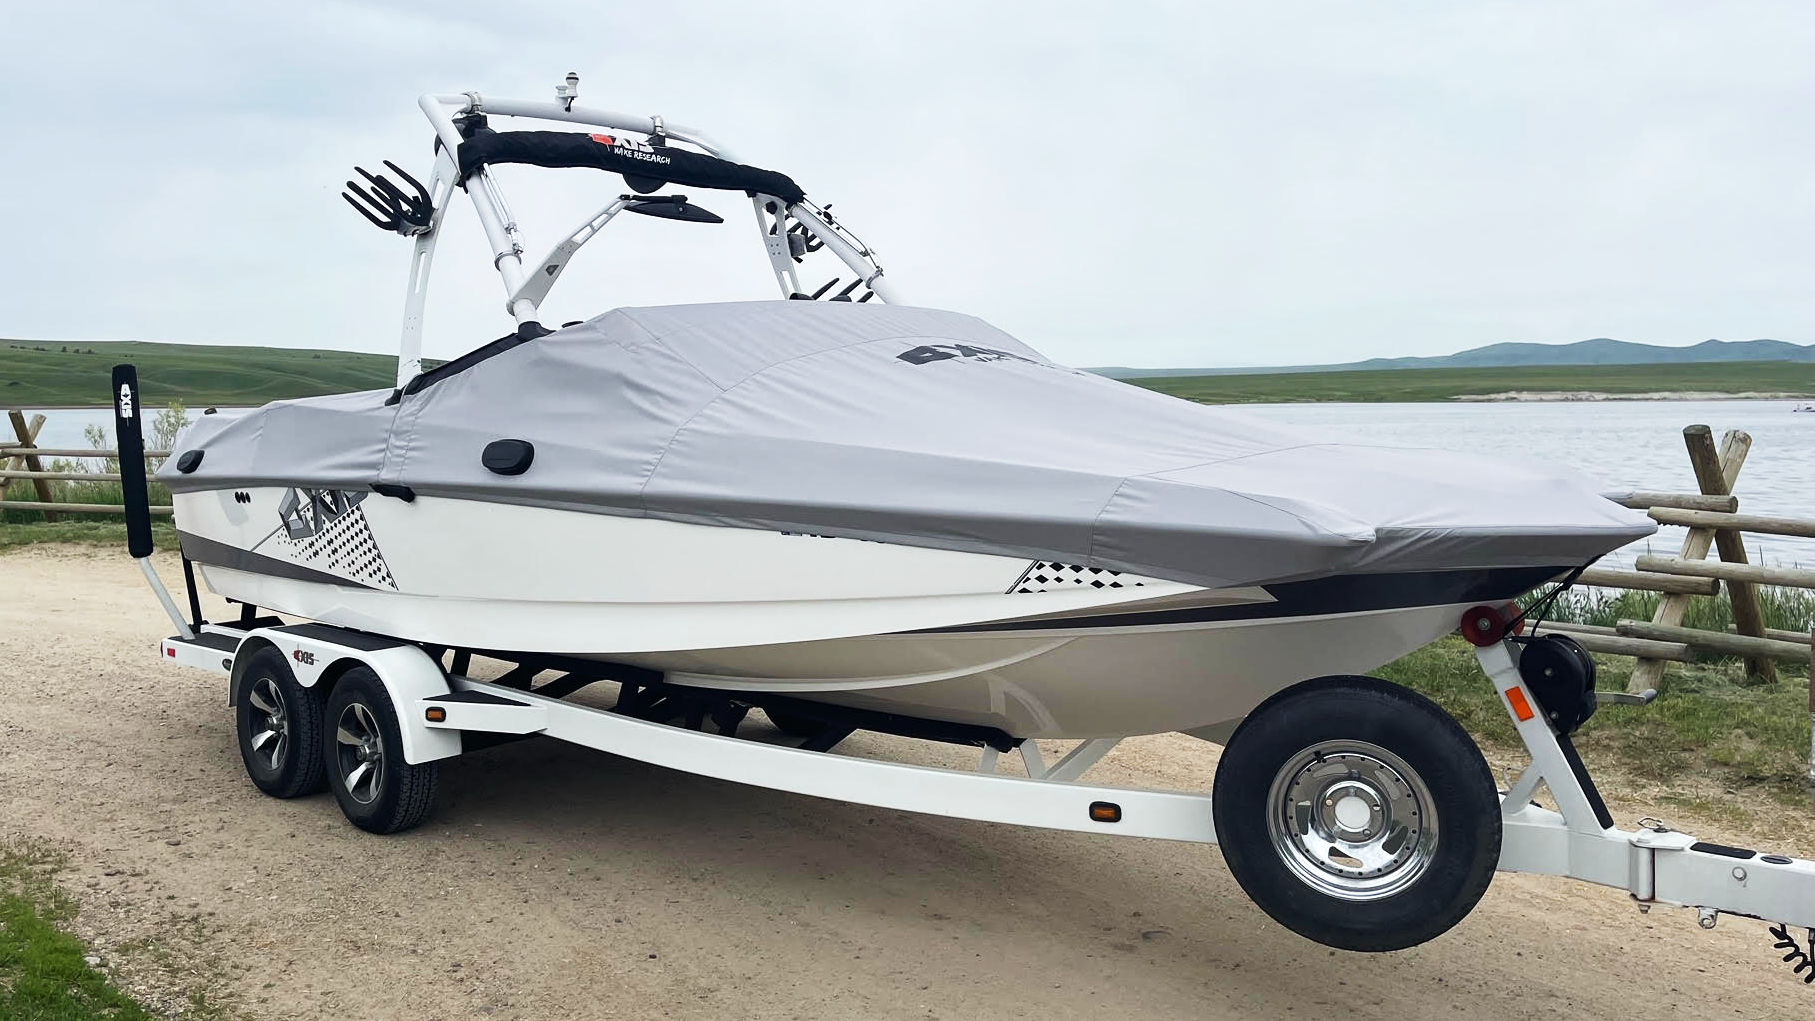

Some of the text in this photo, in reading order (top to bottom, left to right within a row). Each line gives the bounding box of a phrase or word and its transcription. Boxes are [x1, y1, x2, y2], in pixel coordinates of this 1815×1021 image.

[614, 146, 671, 165] WAKE RESEARCH
[120, 383, 133, 418] AXIS
